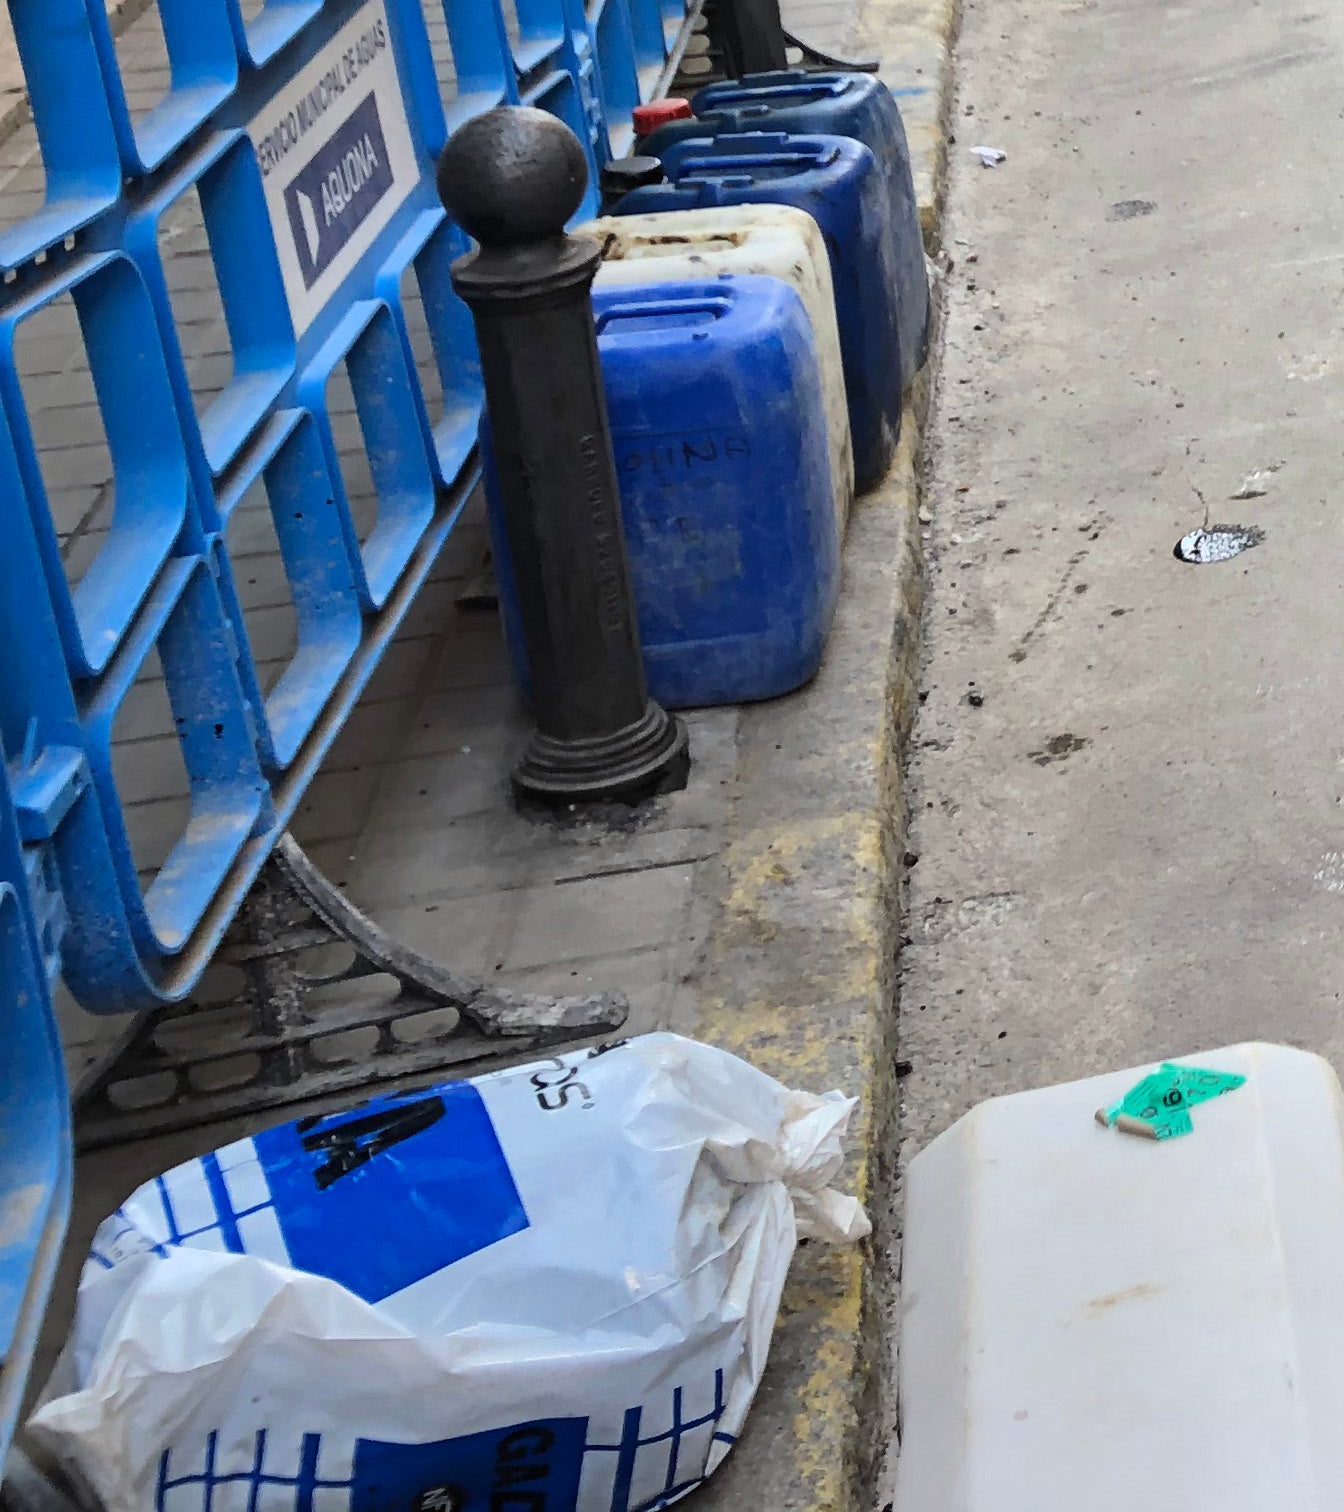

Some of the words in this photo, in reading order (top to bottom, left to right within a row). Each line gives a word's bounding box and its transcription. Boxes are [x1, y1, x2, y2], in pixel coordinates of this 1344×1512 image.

[258, 111, 298, 177] ERVICIO
[295, 63, 346, 137] MUNICIPAL
[342, 47, 358, 85] DE
[356, 19, 386, 65] AGUAS
[321, 132, 379, 227] AQUONA
